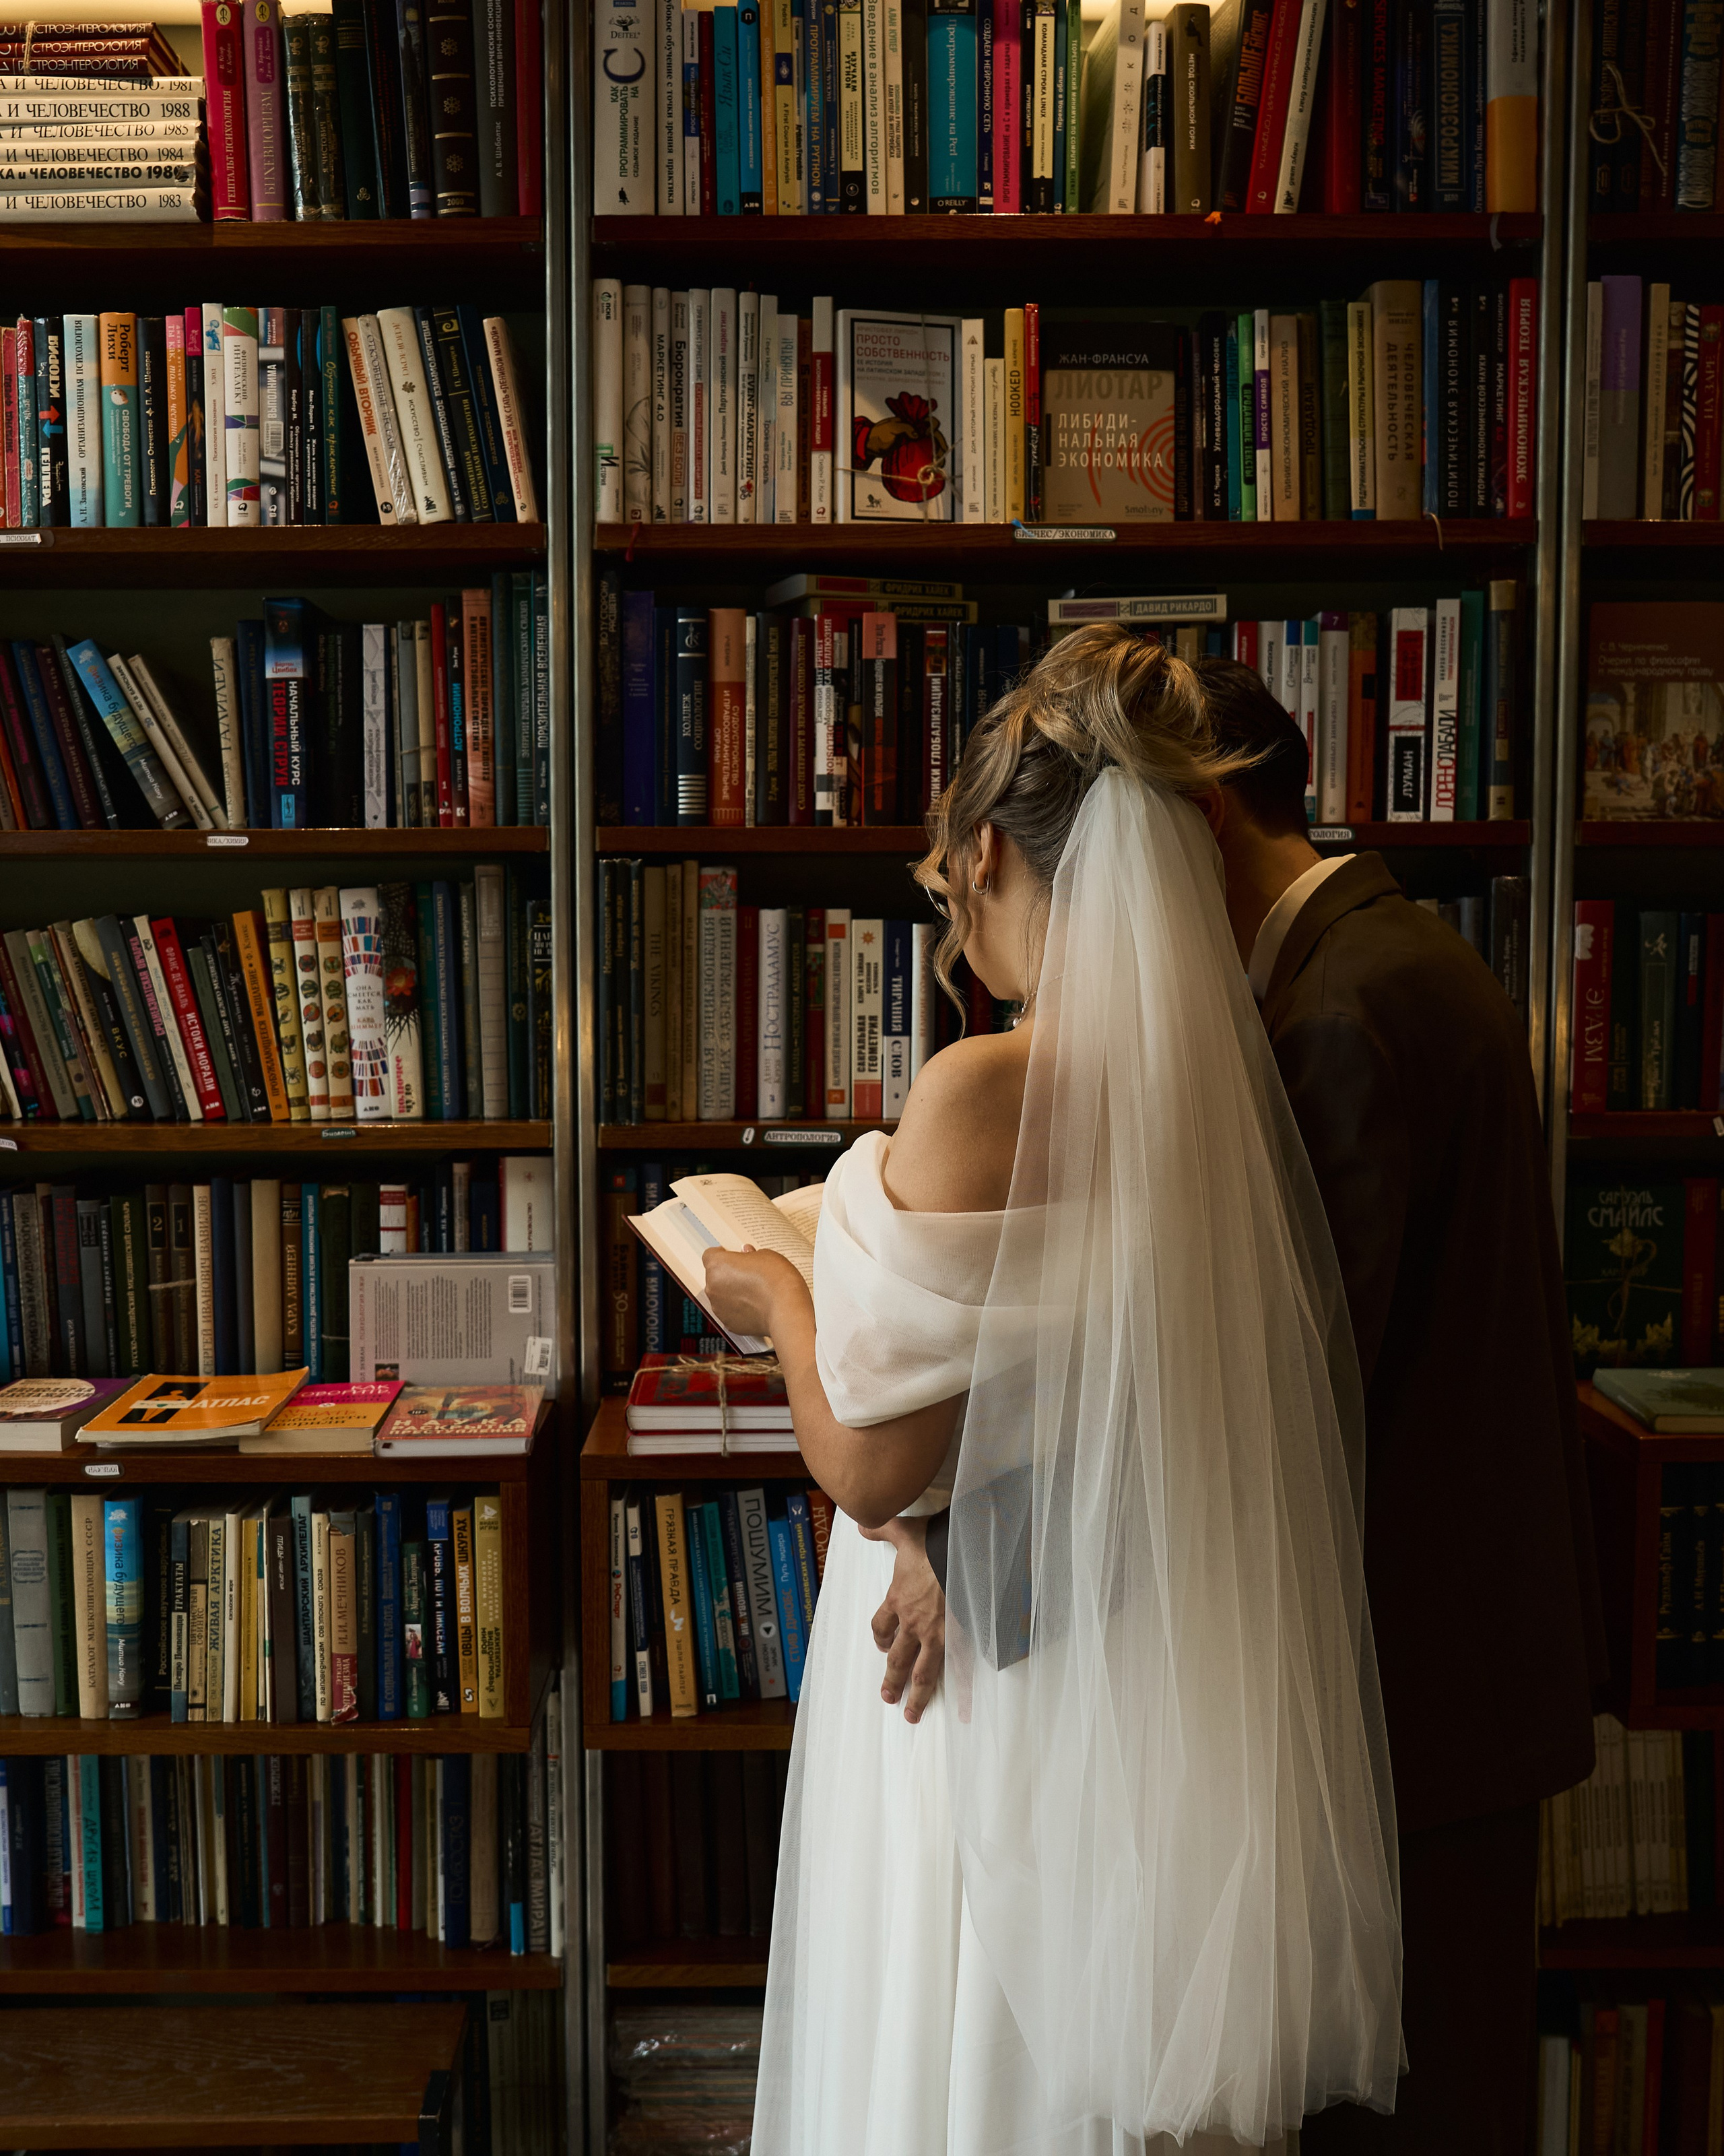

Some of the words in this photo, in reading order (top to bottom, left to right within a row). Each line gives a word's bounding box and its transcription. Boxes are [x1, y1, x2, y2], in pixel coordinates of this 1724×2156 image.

[665, 35, 674, 79] обучение
[983, 18, 991, 57] СОЗДАЕМ
[809, 24, 819, 123] ПРОГРАММИРУЕМ
[946, 19, 958, 119] Программирование
[983, 59, 991, 110] НЕЙРОННУЮ
[1187, 53, 1195, 79] МЕТОД
[7, 104, 20, 117] И
[26, 103, 150, 117] ЧЕЛОВЕЧЕСТВО
[160, 103, 191, 117] 1988
[610, 86, 619, 102] КАК
[630, 86, 639, 98] НА
[869, 72, 878, 117] анализ
[1188, 80, 1197, 124] СКОЛЬЗКОЙ
[1440, 22, 1460, 184] МИКРОЭКОНОМИКА
[10, 127, 22, 139] И
[34, 124, 154, 138] ЧЕЛОВЕЧЕСТВО
[163, 124, 189, 135] 1985
[223, 90, 236, 203] ГЕШТАЛЬТ-ПСИХОЛОГИЯ
[261, 91, 276, 195] БИХЕВИОРИЗМ
[494, 121, 502, 159] Шаболтас
[620, 86, 628, 177] ПРОГРАММИРОВАТЬ
[665, 121, 674, 154] зрения
[811, 127, 820, 141] НА
[949, 120, 956, 135] на
[949, 137, 958, 156] Perl
[983, 113, 991, 133] СЕТЬ
[1071, 125, 1077, 135] ПО
[6, 149, 17, 162] И
[25, 148, 148, 162] ЧЕЛОВЕЧЕСТВО
[157, 147, 184, 160] 1984
[811, 145, 820, 187] PYTHON
[866, 121, 880, 195] алгоритмов
[5, 197, 17, 209] И
[24, 195, 147, 209] ЧЕЛОВЕЧЕСТВО
[158, 195, 181, 207] 1983
[666, 158, 675, 203] практика
[74, 320, 84, 374] ПСИХОЛОГИЯ
[107, 323, 117, 360] Лихи
[119, 324, 131, 372] Роберт
[168, 324, 177, 338] ты
[719, 311, 728, 354] маркетинг
[856, 334, 900, 346] ПРОСТО
[1519, 298, 1531, 352] ТЕОРИЯ
[656, 333, 665, 401] МАРКЕТИНГ
[856, 346, 950, 362] СОБСТВЕННОСТЬ
[1059, 353, 1150, 365] ЖАН-ФРАНСУА
[1447, 319, 1459, 394] ЭКОНОМИЯ
[169, 365, 178, 400] только
[347, 331, 369, 385] ОБЫЧНЫЙ
[358, 388, 376, 436] ВТОРНИК
[672, 340, 686, 428] Бюрократия
[719, 355, 728, 414] Партизанский
[1009, 369, 1021, 417] HOOKED
[1054, 372, 1163, 400] ЛИОТАР
[1259, 378, 1267, 410] СИМВОЛ
[1387, 342, 1398, 461] ДЕЯТЕЛЬНОСТЬ
[1404, 343, 1414, 461] ЧЕЛОВЕЧЕСКАЯ
[1496, 362, 1504, 423] МАРКЕТИНГ
[76, 379, 86, 459] ОРГАНИЗАЦИОННАЯ
[122, 409, 131, 453] СВОБОДА
[657, 403, 665, 422] 4.0
[746, 373, 755, 480] EVENT-МАРКЕТИНГ
[1058, 413, 1137, 430] ЛИБИДИ-
[1260, 412, 1268, 442] ПРОСТО
[1516, 359, 1530, 484] ЭКОНОМИЧЕСКАЯ
[123, 454, 131, 467] ОТ
[675, 434, 684, 455] БЕЗ
[1058, 432, 1139, 449] НАЛЬНАЯ
[1058, 451, 1164, 468] ЭКОНОМИКА
[1447, 401, 1459, 508] ПОЛИТИЧЕСКАЯ
[41, 447, 52, 507] ГЕЛЛЕРА
[123, 468, 133, 508] ТРЕВОГИ
[673, 457, 683, 484] БОЛИ
[1135, 601, 1168, 614] ДАВИД
[1170, 600, 1212, 613] РИКАРДО
[537, 615, 548, 670] ВСЕЛЕННАЯ
[272, 680, 288, 737] ТЕОРИИ
[288, 680, 300, 754] НАЧАЛЬНЫЙ
[451, 682, 463, 752] АСТРОНОМИИ
[537, 672, 549, 748] ПОРАЗИТЕЛЬНАЯ
[930, 678, 943, 765] ГЛОБАЛИЗАЦИИ
[273, 740, 289, 787] СТРУН
[290, 754, 301, 786] КУРС
[1403, 750, 1414, 798] ЛУМАН
[248, 969, 265, 1016] МЫШЛЕНИЕ
[702, 917, 717, 1039] ЭНЦИКЛОПЕДИЯ
[718, 916, 733, 1041] ЗАБЛУЖДЕНИЙ
[857, 1014, 866, 1073] САКРАЛЬНАЯ
[867, 1014, 878, 1073] ГЕОМЕТРИЯ
[1584, 987, 1605, 1063] ЭРАЗМ
[258, 1020, 279, 1097] ПРОБУЖДАЮЩЕЕСЯ
[704, 1047, 715, 1109] ПОЛНАЯ
[720, 1047, 732, 1109] НАШИХ
[197, 1195, 209, 1253] ВАВИЛОВ
[199, 1257, 212, 1324] ИВАНОВИЧ
[286, 1244, 298, 1300] ЛИННЕЙ
[286, 1303, 298, 1336] КАРЛ
[201, 1328, 214, 1375] СЕРГЕЙ
[190, 1395, 271, 1408] АТЛАС
[393, 1418, 527, 1427] НАУКА
[85, 1517, 93, 1546] СССР
[298, 1513, 309, 1573] АРХИПЕЛАГ
[455, 1517, 469, 1563] ШКУРАХ
[211, 1527, 222, 1594] АРКТИКА
[745, 1498, 773, 1616] ПОШУМИМ
[86, 1550, 95, 1641] МЛЕКОПИТАЮЩИХ
[174, 1563, 184, 1610] ТРАКТАТЫ
[335, 1548, 347, 1620] МЕЧНИКОВ
[458, 1564, 471, 1614] ВОЛЧЬИХ
[209, 1600, 220, 1651] ЖИВАЯ
[300, 1577, 312, 1645] ШАНТАРСКИЙ
[339, 1622, 347, 1633] И.
[461, 1615, 471, 1623] В
[781, 1588, 797, 1630] ДЖОБС
[339, 1634, 348, 1645] И.
[460, 1625, 473, 1656] ОВЦЫ
[787, 1633, 801, 1662] СТИВ
[87, 1644, 97, 1688] КАТАЛОГ
